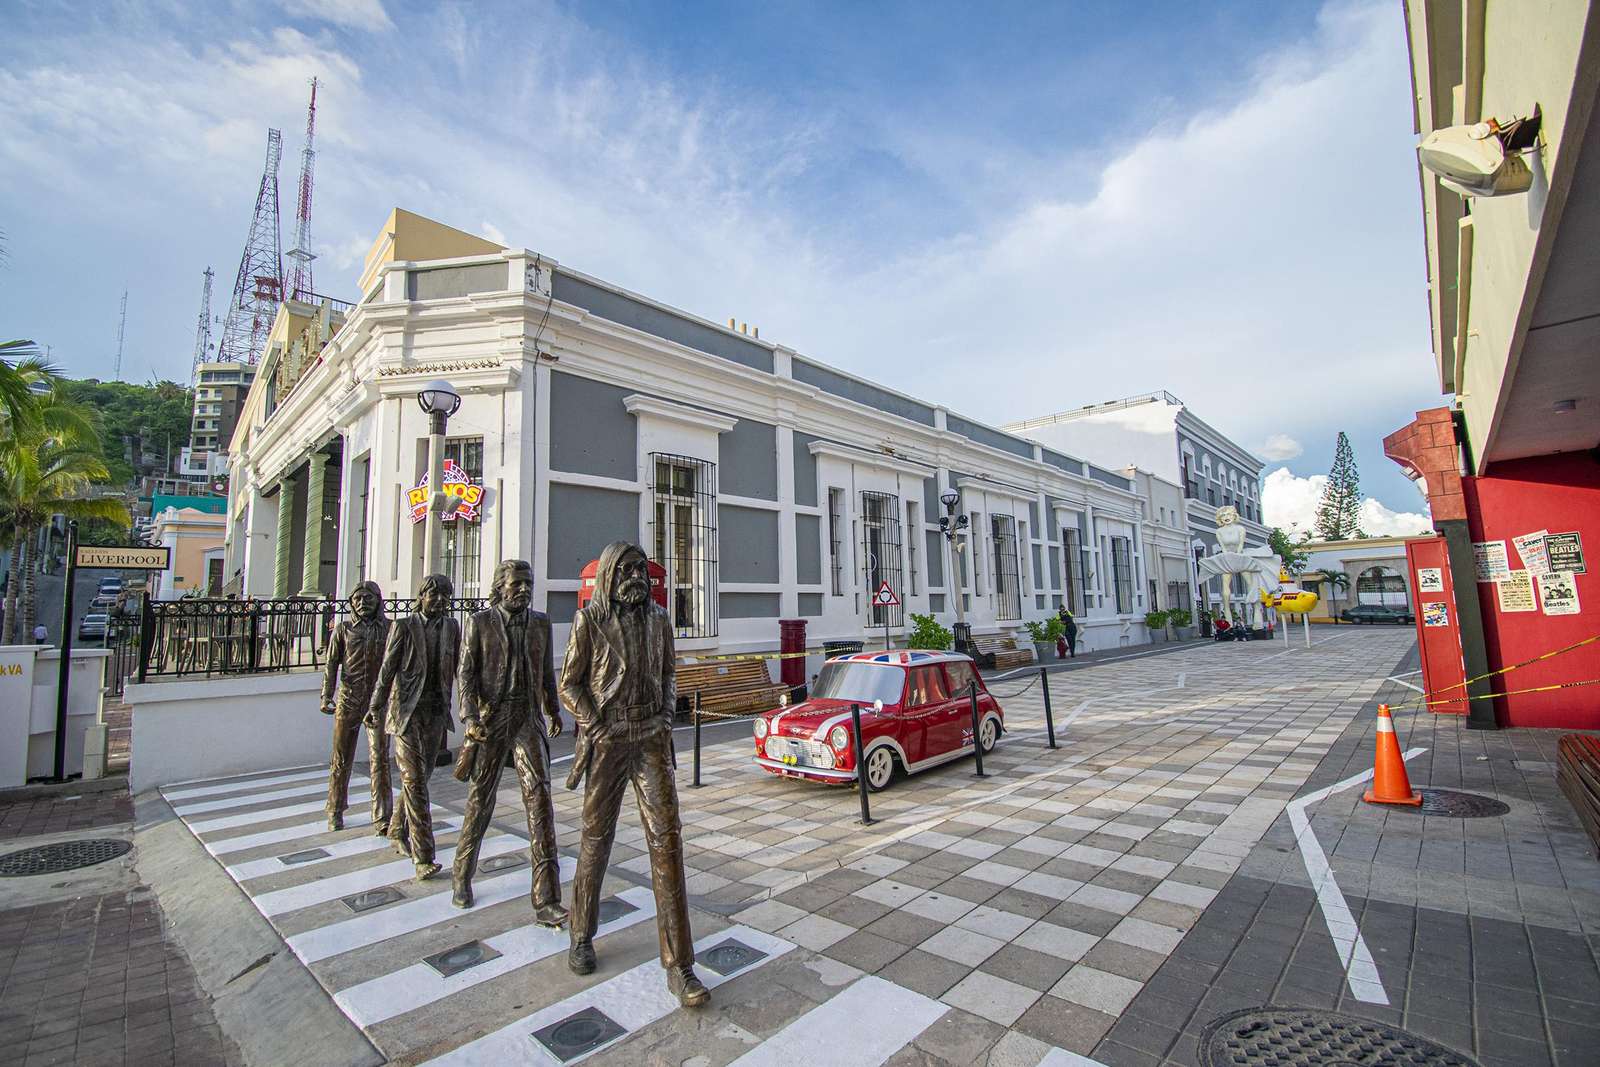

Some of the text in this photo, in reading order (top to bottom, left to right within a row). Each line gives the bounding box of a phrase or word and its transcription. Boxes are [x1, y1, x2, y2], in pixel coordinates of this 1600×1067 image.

[1549, 544, 1580, 554] BEATLES
[81, 554, 165, 565] LIVERPOOL
[1544, 600, 1570, 608] Beatles
[8, 663, 23, 676] VA
